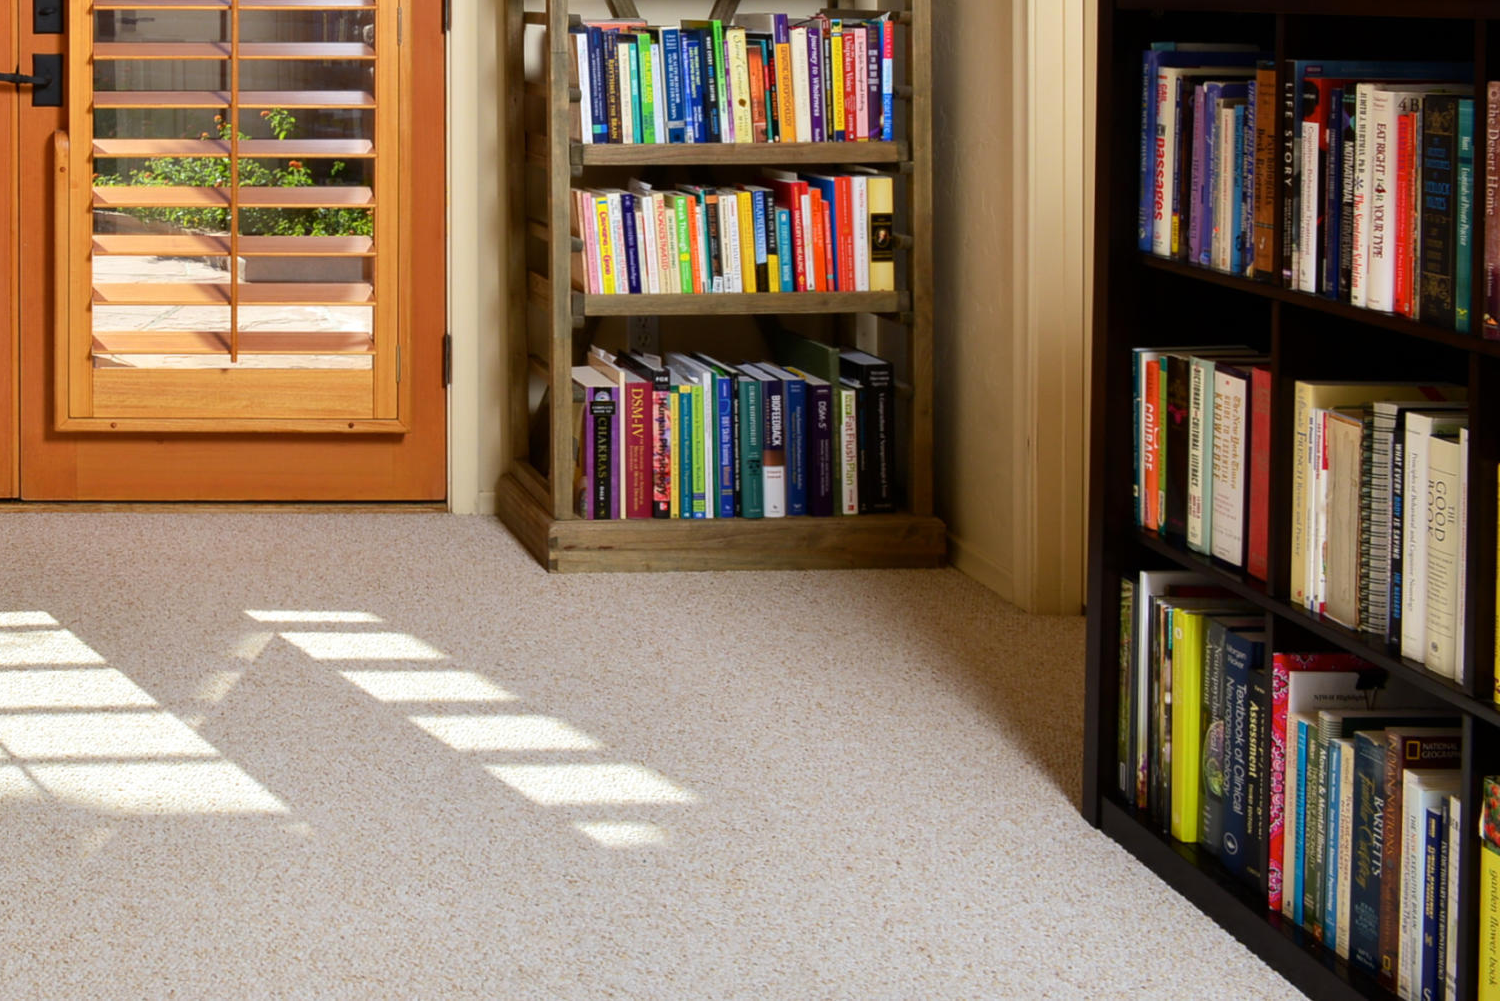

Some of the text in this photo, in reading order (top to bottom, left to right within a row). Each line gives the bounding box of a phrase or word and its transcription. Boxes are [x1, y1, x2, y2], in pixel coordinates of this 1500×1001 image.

[608, 59, 617, 94] RHYTHMS
[644, 51, 652, 86] HEALING
[808, 33, 821, 117] Journey to Wholeness
[843, 35, 854, 92] Unspoken Voice
[1284, 82, 1293, 187] LIFE STORY
[1375, 122, 1387, 143] EAT
[1460, 136, 1471, 150] Hunt
[1154, 137, 1167, 221] passages
[1374, 143, 1386, 175] RIGHT
[1485, 103, 1498, 216] the Desert Home
[1459, 167, 1470, 195] Essentials
[677, 198, 688, 252] Break Through
[767, 197, 775, 219] BRAIN
[794, 209, 803, 238] IMAGERY
[1341, 140, 1355, 269] MOTIVATIONAL INTERVIEWING
[1373, 204, 1385, 231] YOUR
[1458, 202, 1469, 222] Private
[768, 220, 775, 231] ON
[1303, 215, 1312, 255] Treatment
[1351, 192, 1364, 289] The Serotonin Solution
[1458, 222, 1469, 246] Practice
[602, 255, 612, 275] Good
[795, 246, 804, 272] HEALING
[1372, 234, 1384, 259] TYPE
[1192, 368, 1202, 410] DICTIONARY
[1223, 395, 1231, 421] GUIDE
[631, 388, 645, 439] DSM-IV
[770, 394, 782, 446] BIOFEEDBACK
[1191, 416, 1201, 450] CULTURAL
[596, 416, 608, 479] CHAKRAS
[656, 397, 668, 496] Human Physiology
[845, 415, 856, 486] Fat Flush Plan
[1145, 402, 1155, 472] COURAGE
[1213, 392, 1223, 480] KNOWLEDGE
[1230, 395, 1241, 490] The New York Times
[1296, 430, 1308, 480] FRENCH
[1221, 437, 1230, 483] ESSENTIAL
[1409, 452, 1418, 487] Principles
[1392, 443, 1403, 559] WHAT EVERY BODY IS SAYING
[1409, 495, 1417, 528] Behavioral
[1434, 480, 1447, 542] GOOD
[1447, 505, 1455, 524] THE
[1409, 529, 1417, 543] and
[1392, 572, 1401, 618] JOE NAVARRO
[1222, 675, 1236, 798] Neuropsychology
[1233, 682, 1246, 815] Textbook of Clinical
[1248, 700, 1259, 778] Assessment
[1422, 742, 1458, 750] NATIONAL
[1318, 747, 1327, 785] Movies
[1317, 797, 1326, 831] Mental
[1315, 833, 1324, 863] Illness
[1409, 854, 1417, 900] EXECUTIVE
[1409, 902, 1417, 929] BRAIN
[1488, 870, 1499, 987] garden flower book
